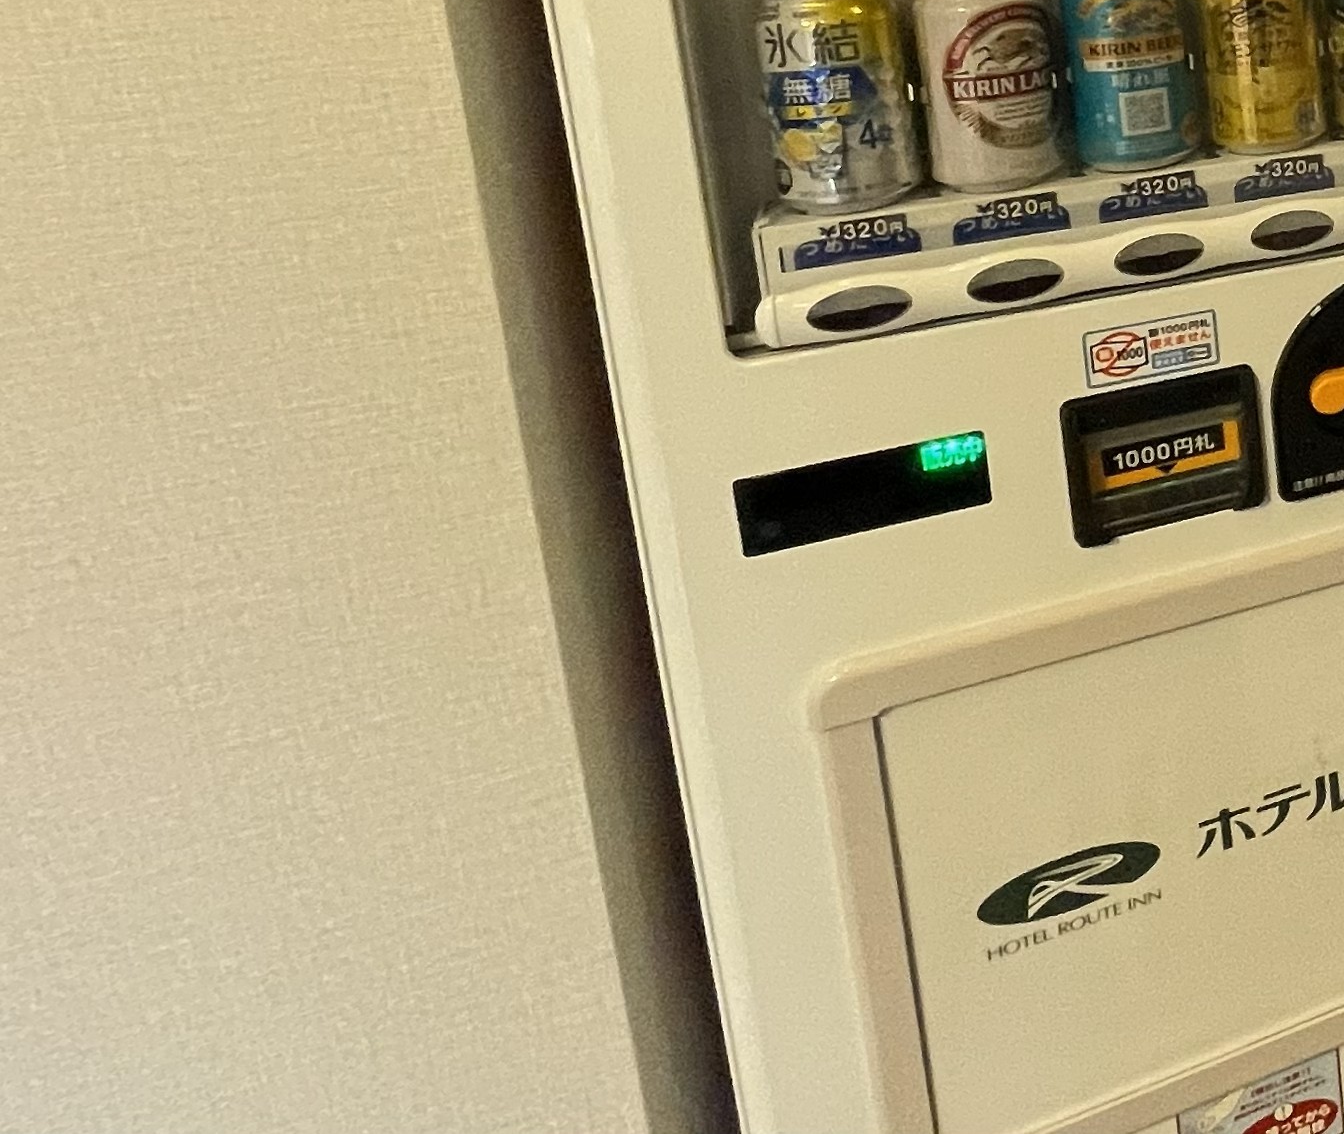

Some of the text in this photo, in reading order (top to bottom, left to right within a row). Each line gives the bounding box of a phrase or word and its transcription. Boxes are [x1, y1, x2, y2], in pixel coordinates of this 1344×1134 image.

[764, 20, 861, 67] 氷結
[1088, 40, 1141, 57] KIRIN
[783, 74, 853, 104] 無糖
[953, 76, 1016, 100] KIRIN
[1112, 432, 1216, 471] 1000円札
[986, 887, 1163, 962] HOTEL ROUTE INN
